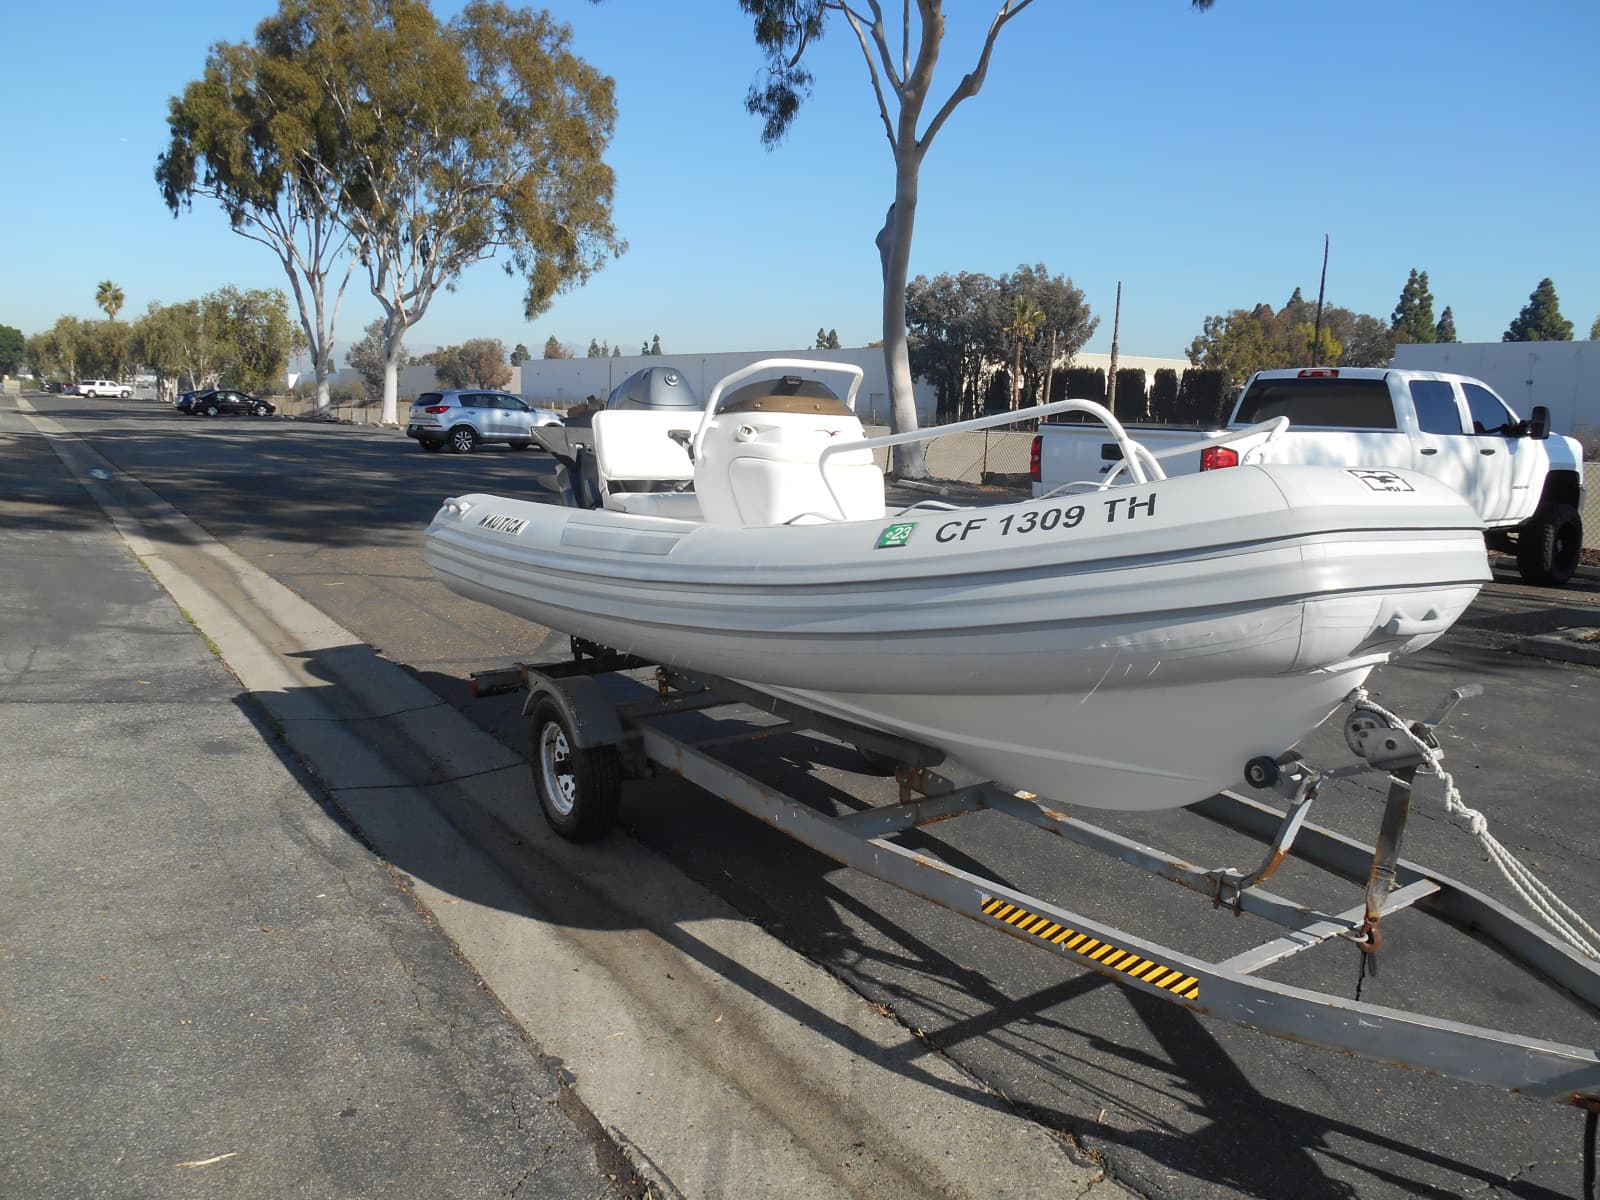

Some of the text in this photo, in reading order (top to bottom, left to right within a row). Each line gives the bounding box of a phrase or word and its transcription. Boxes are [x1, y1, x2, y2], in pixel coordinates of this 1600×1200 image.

[479, 513, 525, 534] NAUTICA
[936, 493, 1156, 543] CF 1309 TH
[890, 526, 912, 540] 23
